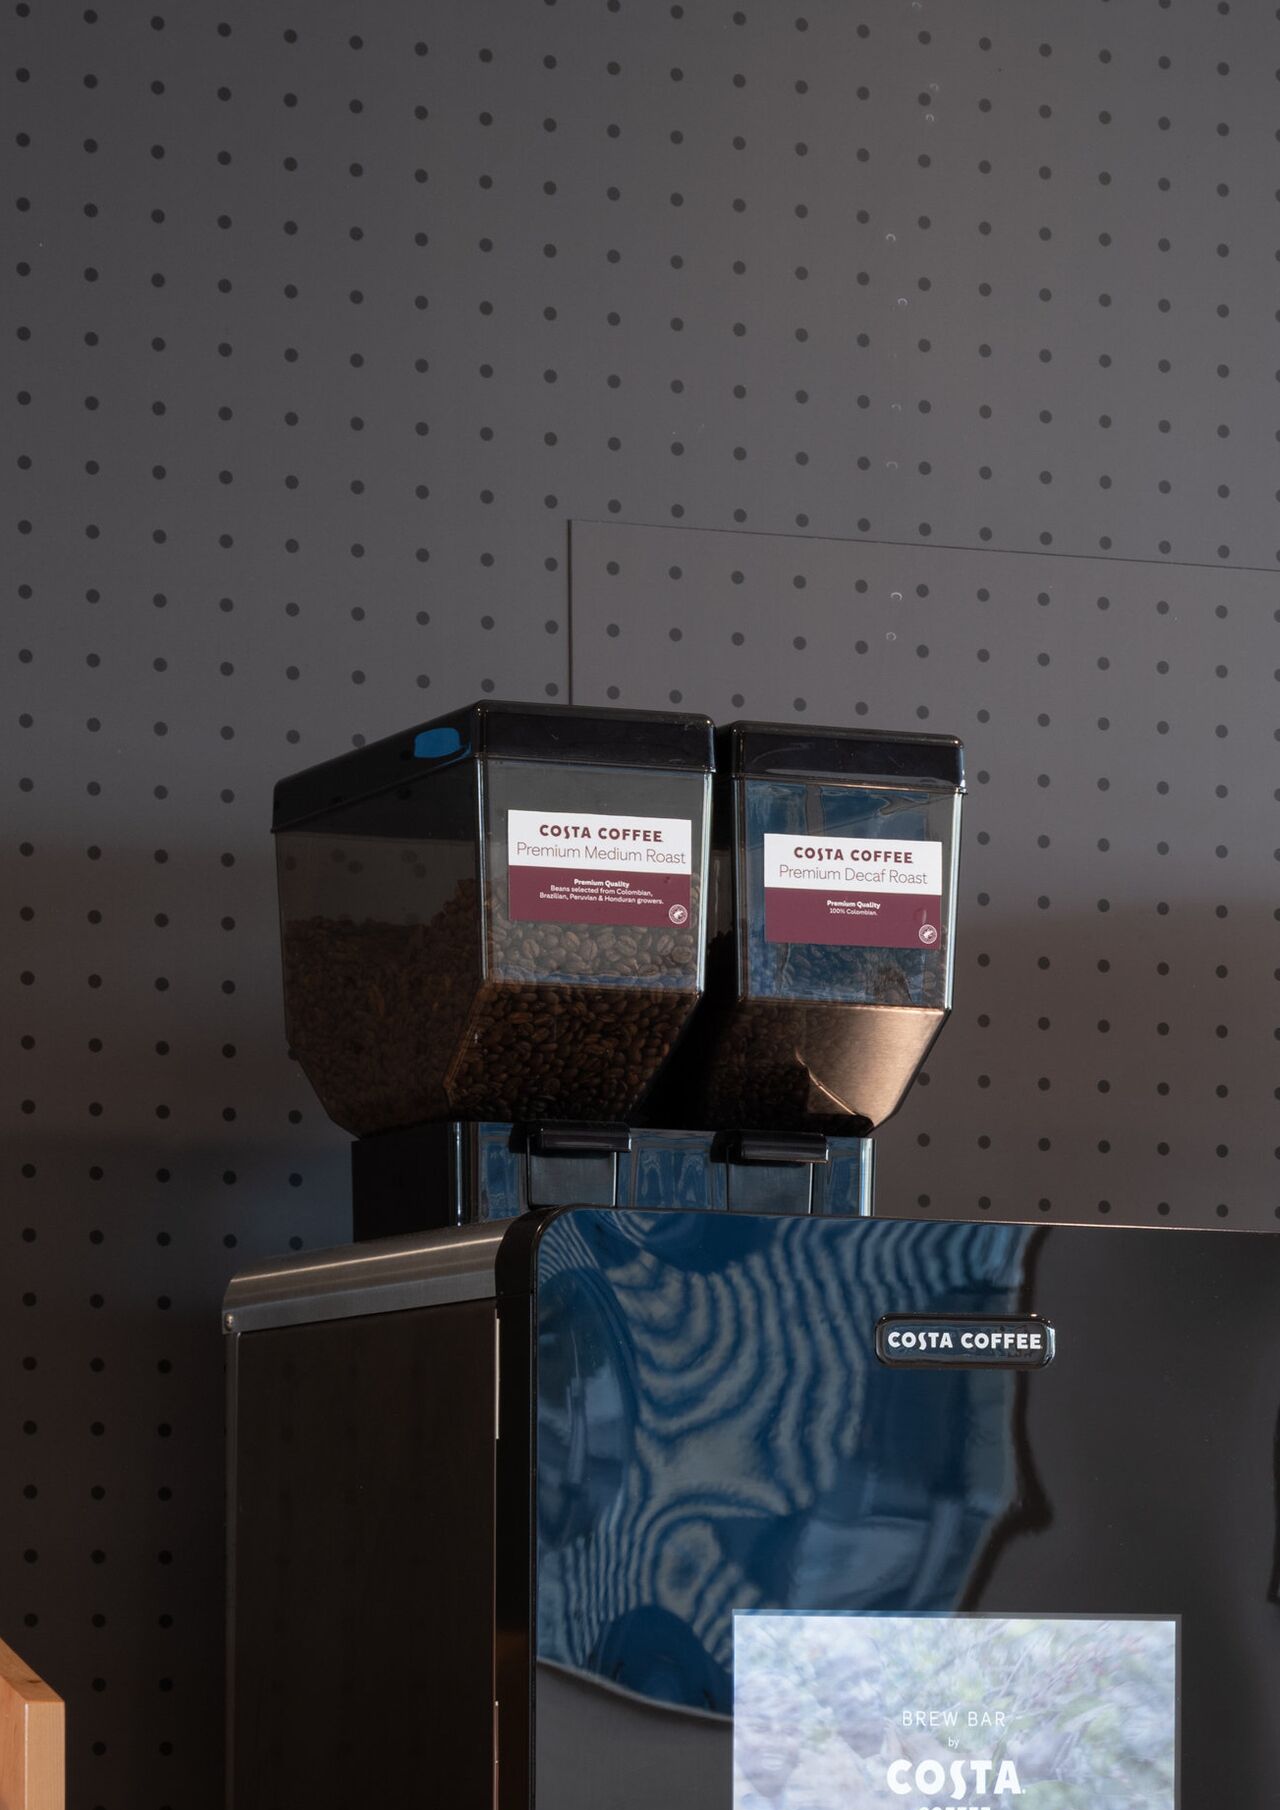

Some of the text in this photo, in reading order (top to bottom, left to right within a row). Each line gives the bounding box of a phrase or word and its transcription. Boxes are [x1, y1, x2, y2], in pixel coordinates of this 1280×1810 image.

[540, 824, 662, 842] COSTA COFFEE
[517, 842, 686, 864] Premium Medium Roast
[794, 846, 913, 864] COSTA COFFEE
[780, 864, 928, 884] Premium Decaf Roast
[551, 885, 570, 893] Beans
[571, 886, 599, 894] selected
[600, 887, 615, 895] from
[574, 878, 630, 889] Premium Quality
[570, 893, 597, 901] Peruvian
[604, 895, 636, 903] Honduran
[827, 900, 881, 910] Premium Quality
[888, 1331, 1042, 1350] COSTA COFFEE
[903, 1711, 1005, 1727] BREW BAR
[948, 1737, 960, 1749] by
[887, 1760, 1022, 1800] COSTA
